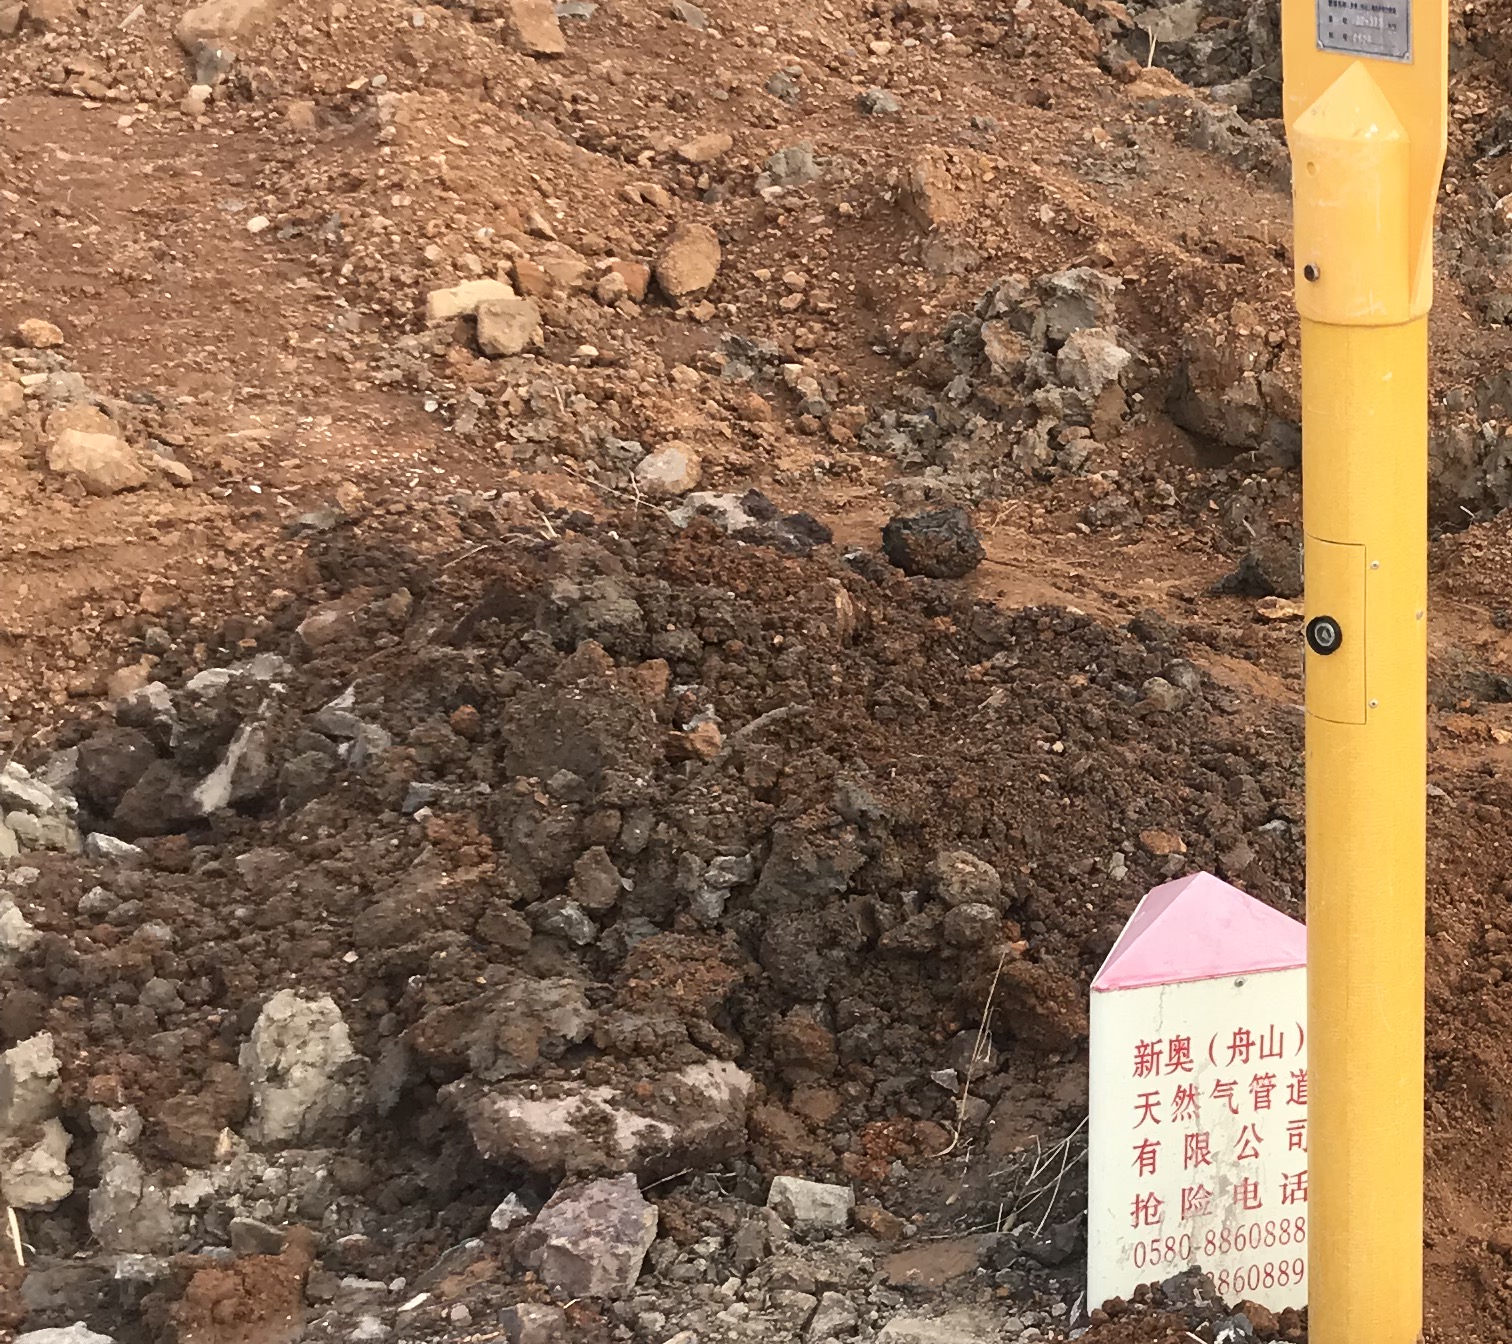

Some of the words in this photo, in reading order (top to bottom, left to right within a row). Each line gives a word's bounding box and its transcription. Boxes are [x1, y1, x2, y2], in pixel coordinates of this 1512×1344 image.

[1132, 1068, 1308, 1130] 天然气管道
[1131, 1118, 1308, 1178] 有限公司
[1130, 1170, 1308, 1230] 抢险电话
[1133, 1216, 1306, 1269] 0580-8860888
